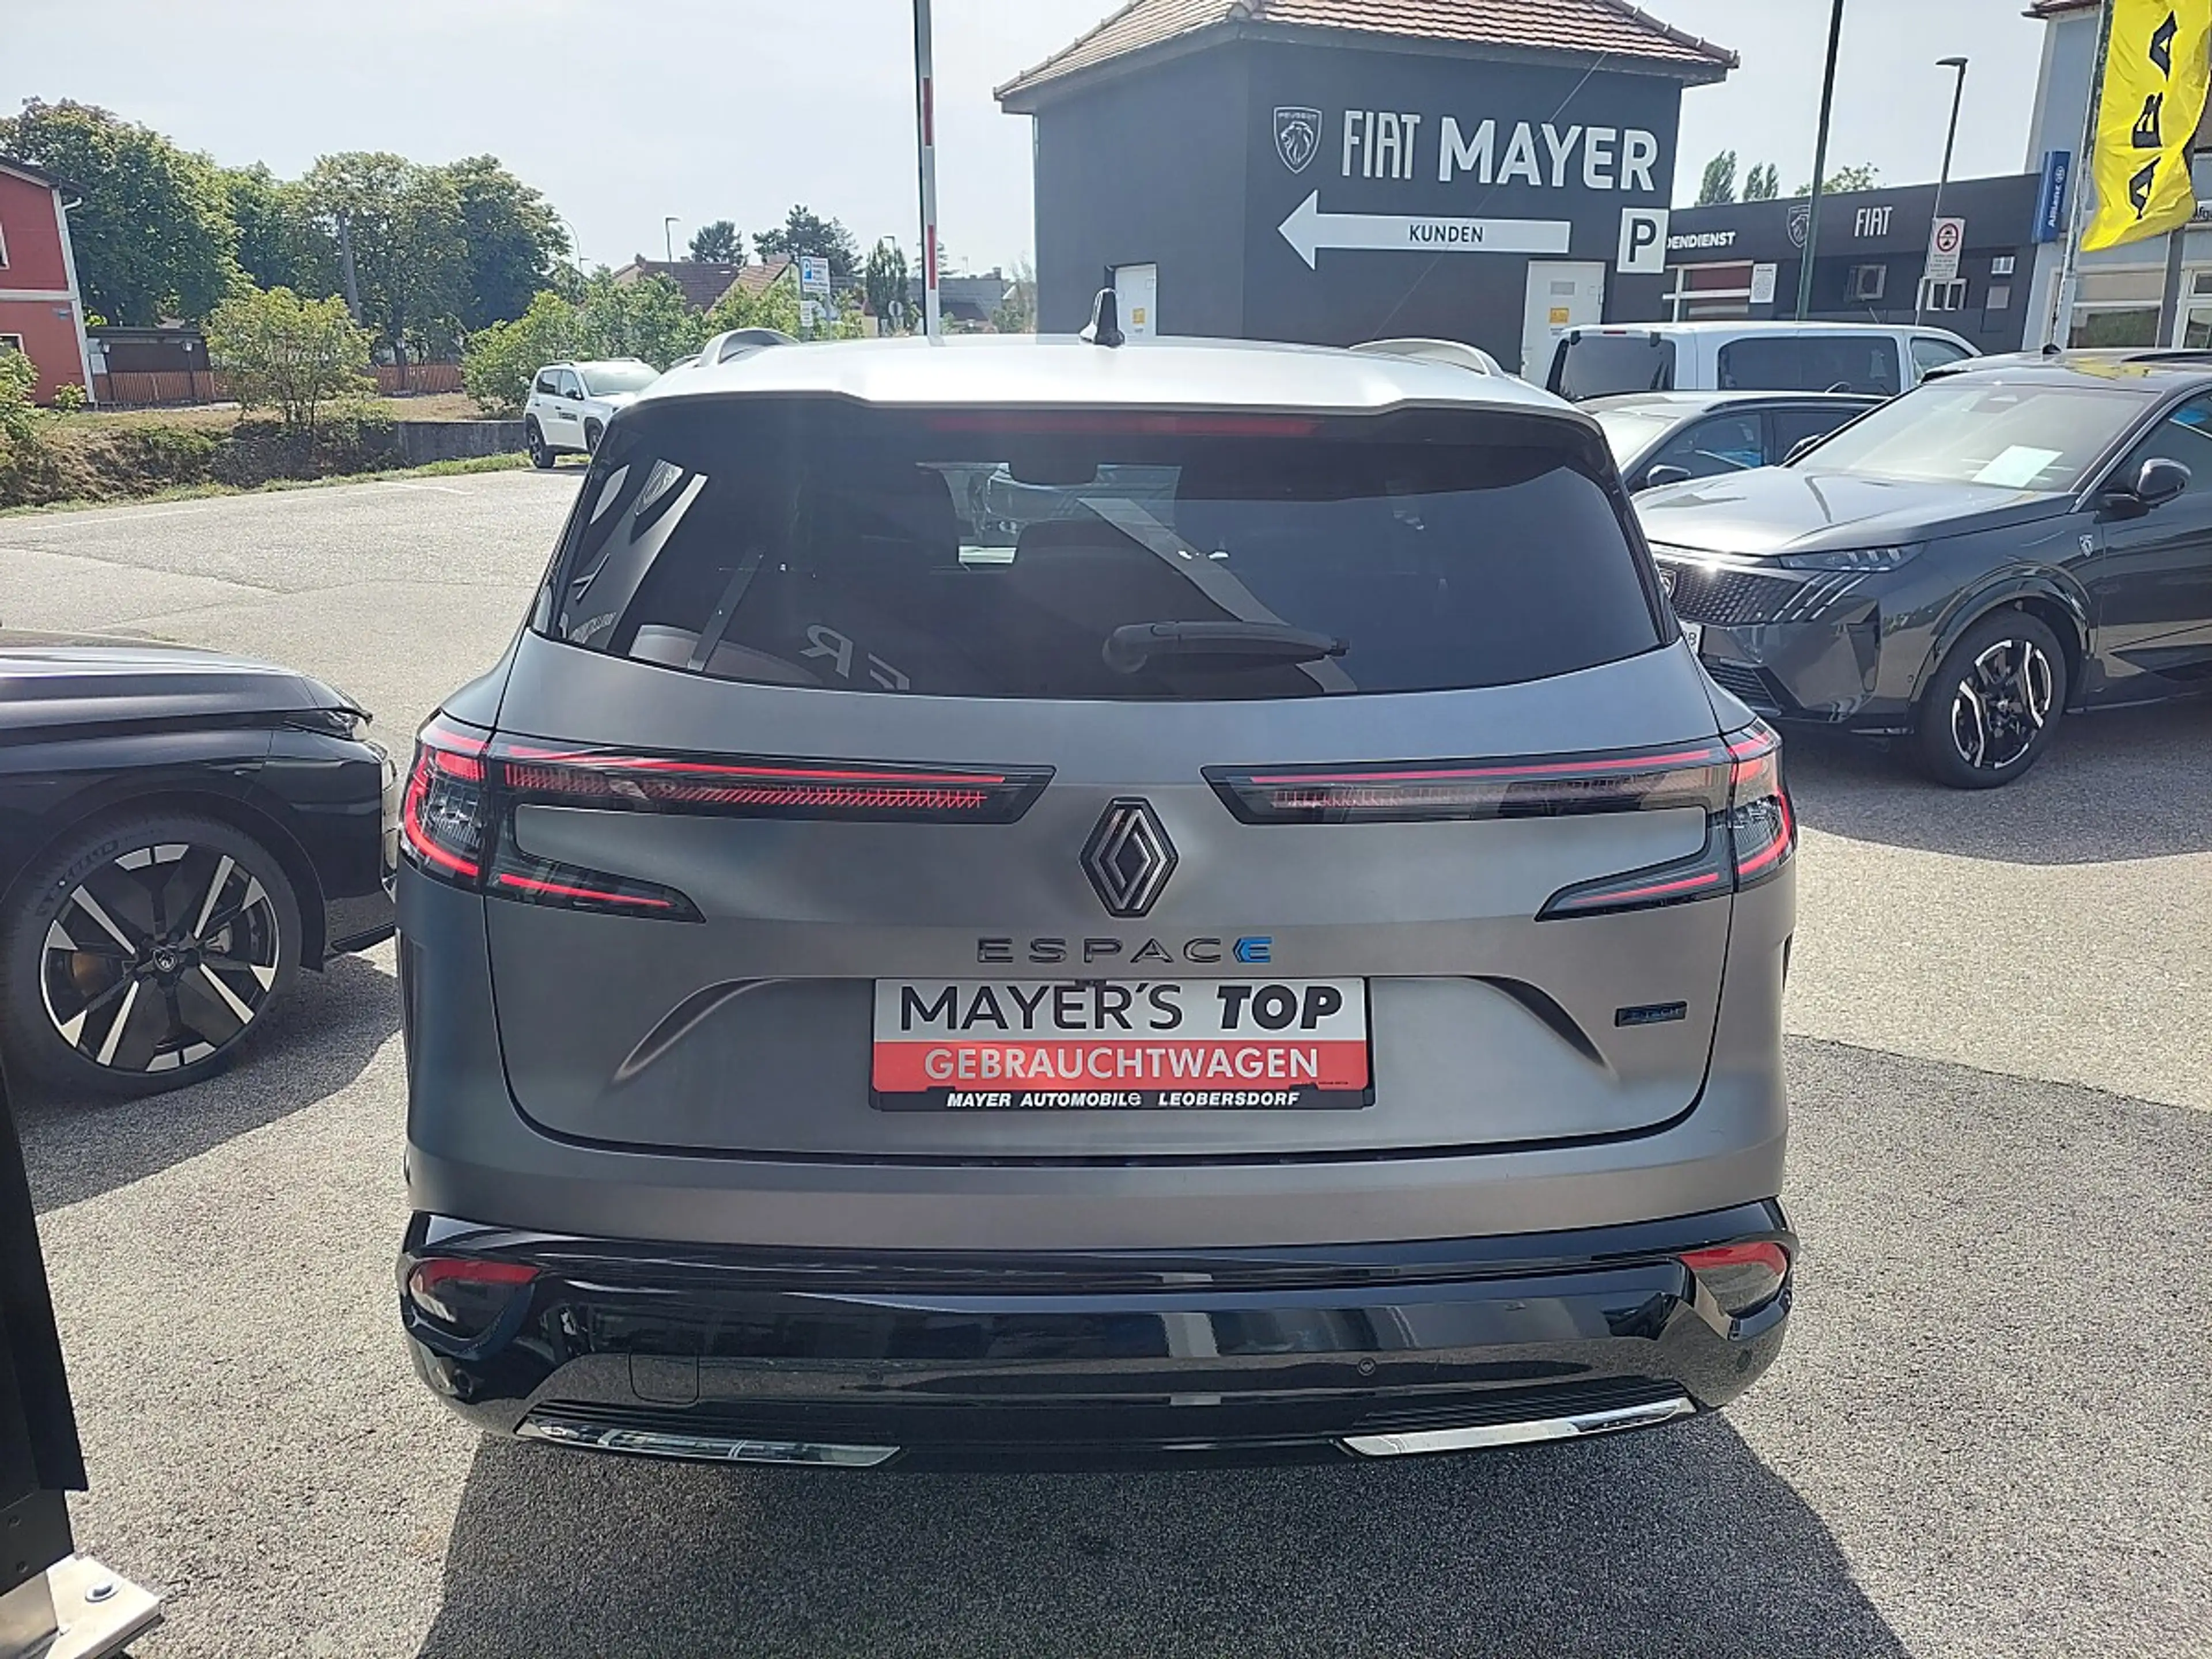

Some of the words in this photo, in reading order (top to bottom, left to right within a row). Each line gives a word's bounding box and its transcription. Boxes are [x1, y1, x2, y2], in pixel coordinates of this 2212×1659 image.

[1342, 111, 1421, 179] FIAT
[1439, 117, 1659, 191] MAYER
[1409, 224, 1483, 243] KUNDEN
[1854, 206, 1893, 237] FIAT
[1628, 217, 1657, 263] P
[978, 937, 1272, 964] ESPACE
[901, 983, 1183, 1031] MAYER'S
[1217, 985, 1343, 1030] TOP
[925, 1048, 1318, 1080] GEBRAUCHTWAGEN
[946, 1093, 1012, 1107] MAYER
[1157, 1092, 1300, 1106] LEOBERSDORF
